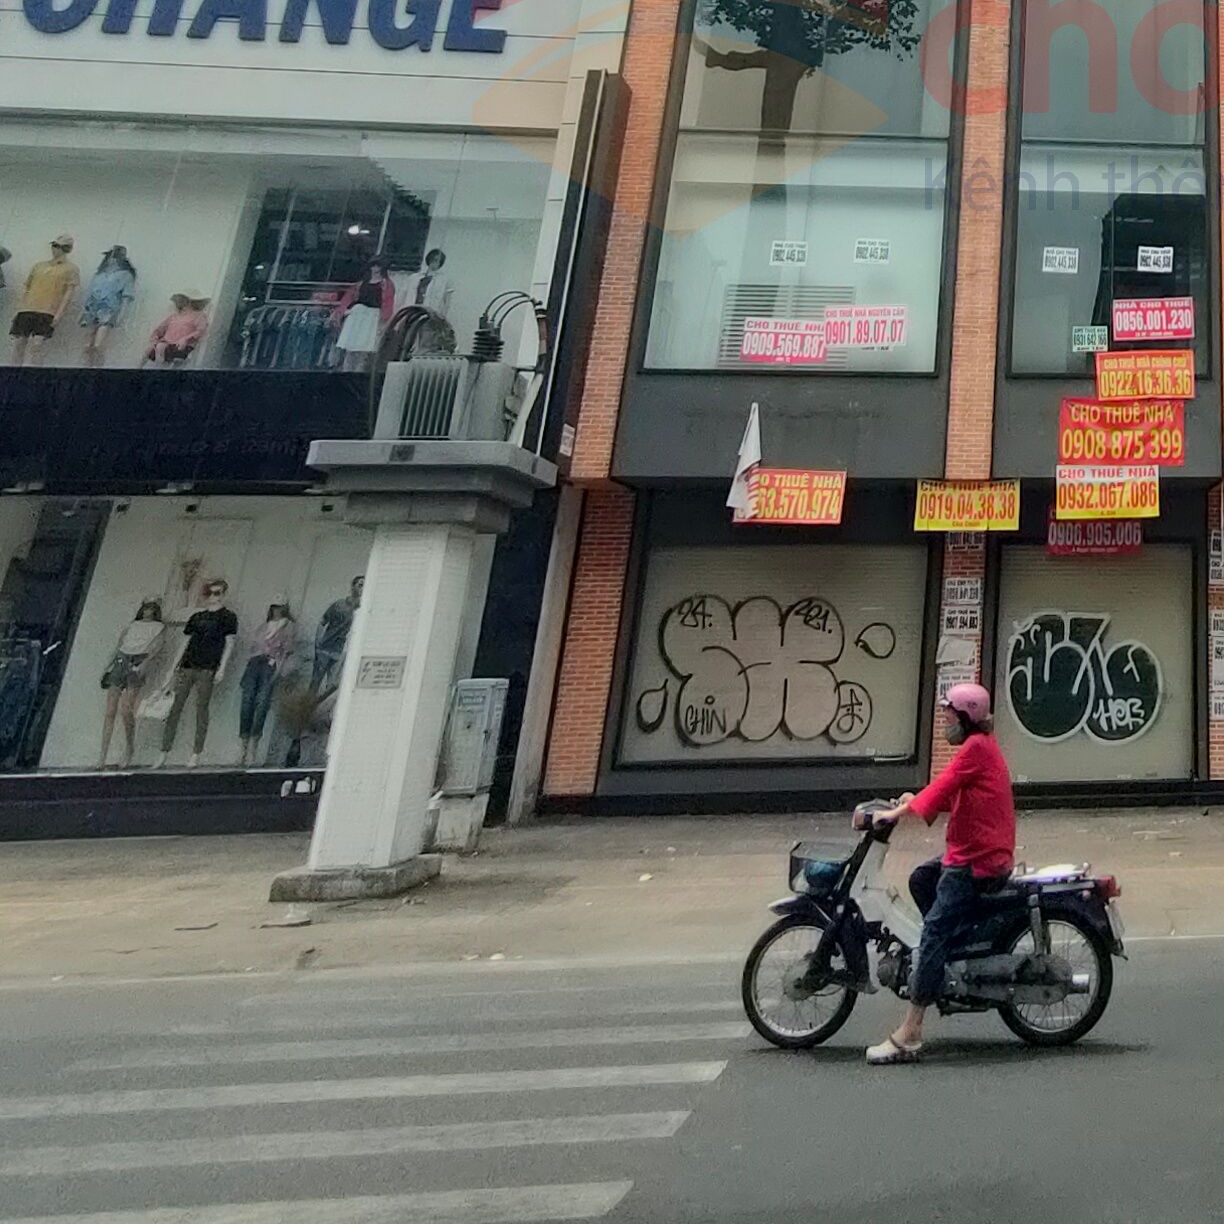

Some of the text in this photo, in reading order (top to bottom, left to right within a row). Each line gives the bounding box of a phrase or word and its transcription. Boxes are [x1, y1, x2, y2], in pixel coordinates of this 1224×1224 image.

[746, 320, 769, 330] CHO
[825, 319, 904, 345] 0901.89.07.07
[1116, 308, 1191, 331] 0856.001.230
[742, 332, 825, 358] 0909.569.887
[1101, 370, 1191, 396] 0922.16.36.36
[1071, 401, 1174, 424] CHO THUÊ NHÀ
[1062, 428, 1182, 459] 0908 875 399
[774, 472, 809, 488] THUÊ
[812, 473, 842, 488] NHÀ
[1059, 468, 1085, 478] CHO
[920, 480, 946, 492] CHO
[1058, 481, 1157, 510] 0932.067.086
[736, 488, 840, 520] 63.570.974
[920, 493, 1016, 520] 0919.04.38.38
[1048, 522, 1142, 546] 0906.905.006
